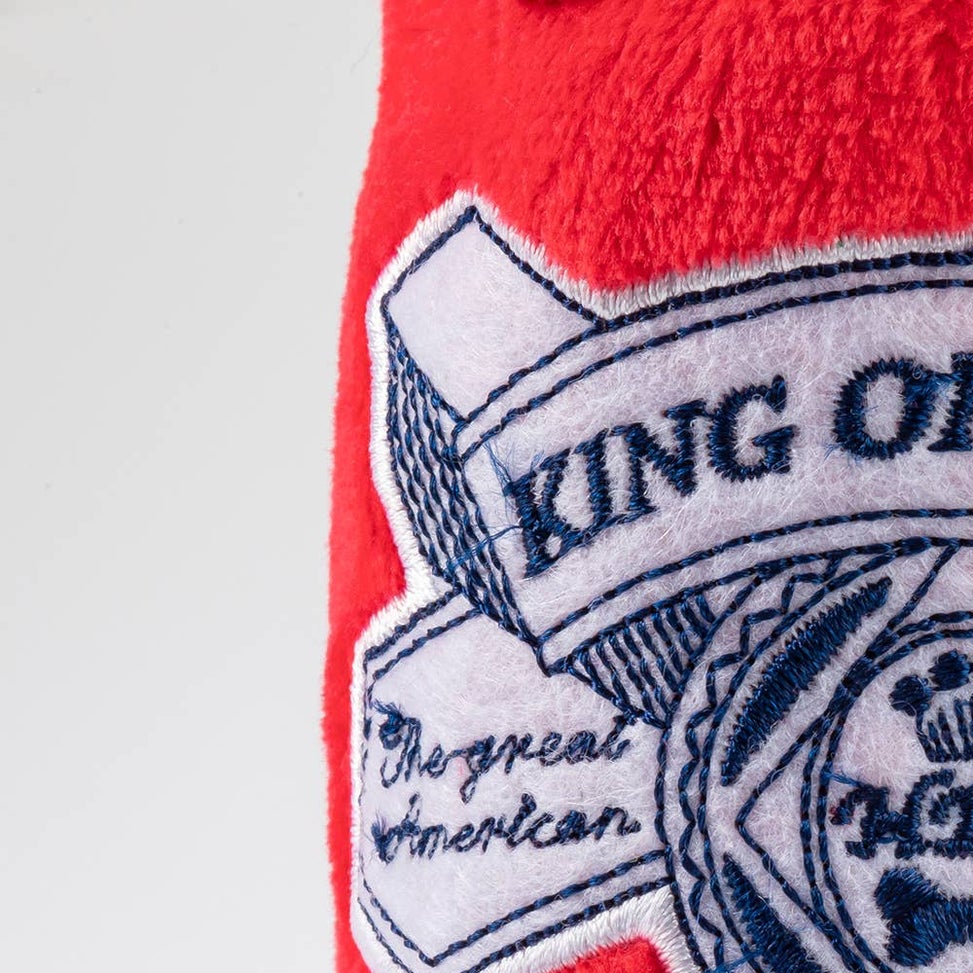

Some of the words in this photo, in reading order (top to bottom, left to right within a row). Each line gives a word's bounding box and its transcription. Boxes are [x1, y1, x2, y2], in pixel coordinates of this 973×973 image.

[508, 375, 796, 576] KING
[374, 706, 452, 788] The
[460, 714, 631, 803] great
[372, 793, 642, 864] American
